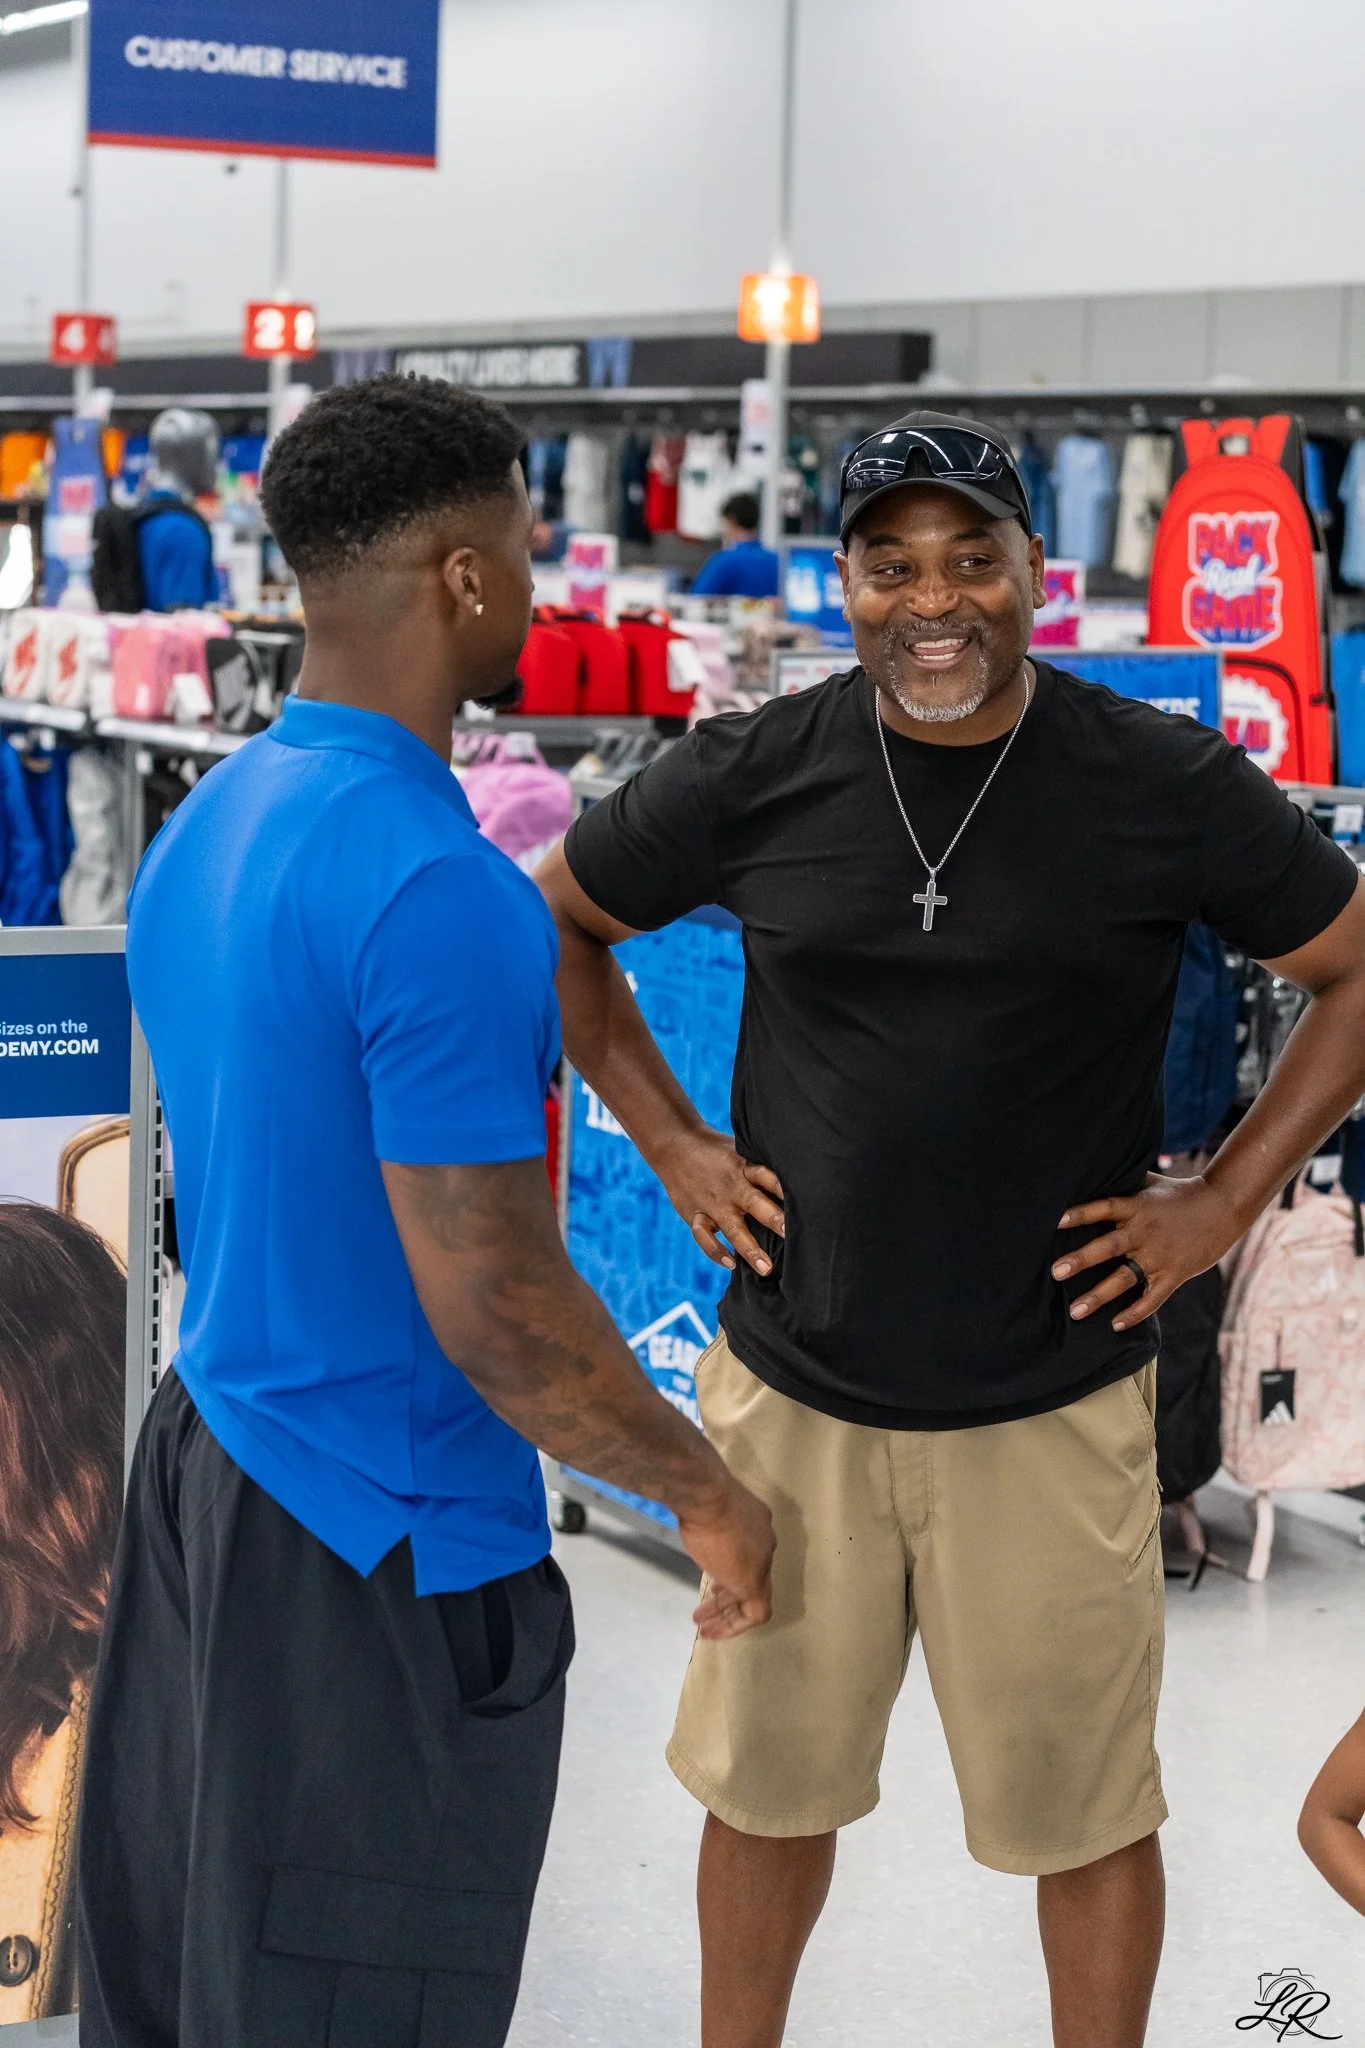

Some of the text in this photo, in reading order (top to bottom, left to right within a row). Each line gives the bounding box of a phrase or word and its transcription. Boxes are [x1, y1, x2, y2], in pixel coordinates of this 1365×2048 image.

[124, 35, 407, 89] CUSTOMER SERVICE
[60, 319, 86, 354] 4
[253, 308, 285, 350] 2
[0, 1019, 88, 1036] izes on the
